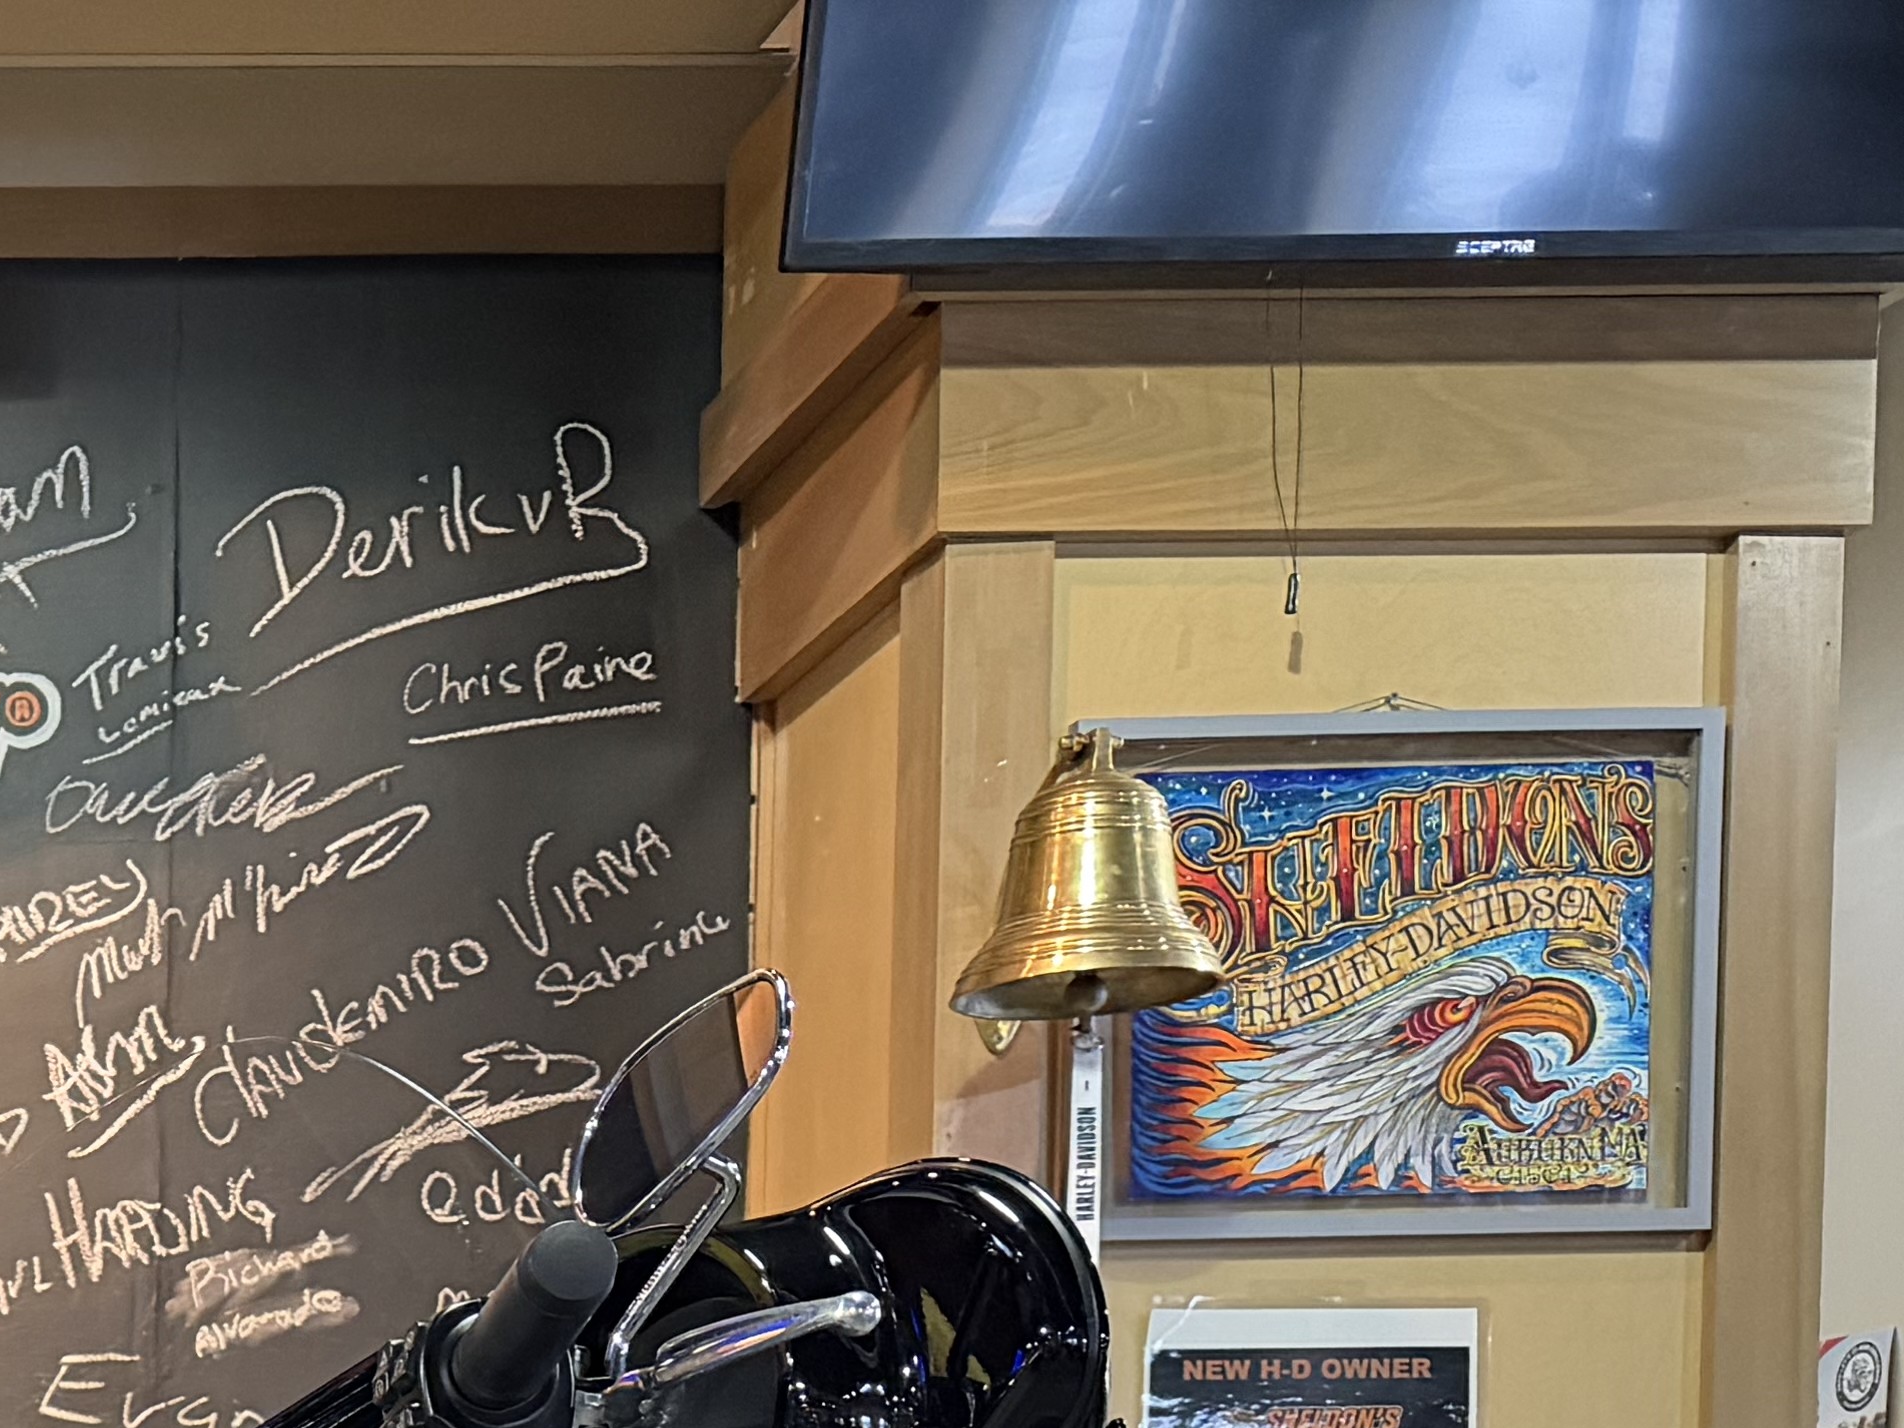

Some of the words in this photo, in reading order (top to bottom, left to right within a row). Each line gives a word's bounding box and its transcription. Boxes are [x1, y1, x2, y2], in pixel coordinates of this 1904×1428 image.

[72, 615, 212, 712] Travis
[402, 660, 522, 716] Chris
[496, 821, 673, 957] VIANA
[1240, 882, 1620, 1031] HARLEY-DAVIDSON
[1075, 1106, 1098, 1222] HARLEY-DAVIDSON
[1182, 1358, 1251, 1381] NEW
[1259, 1358, 1313, 1381] H-D
[1321, 1357, 1433, 1380] OWNER
